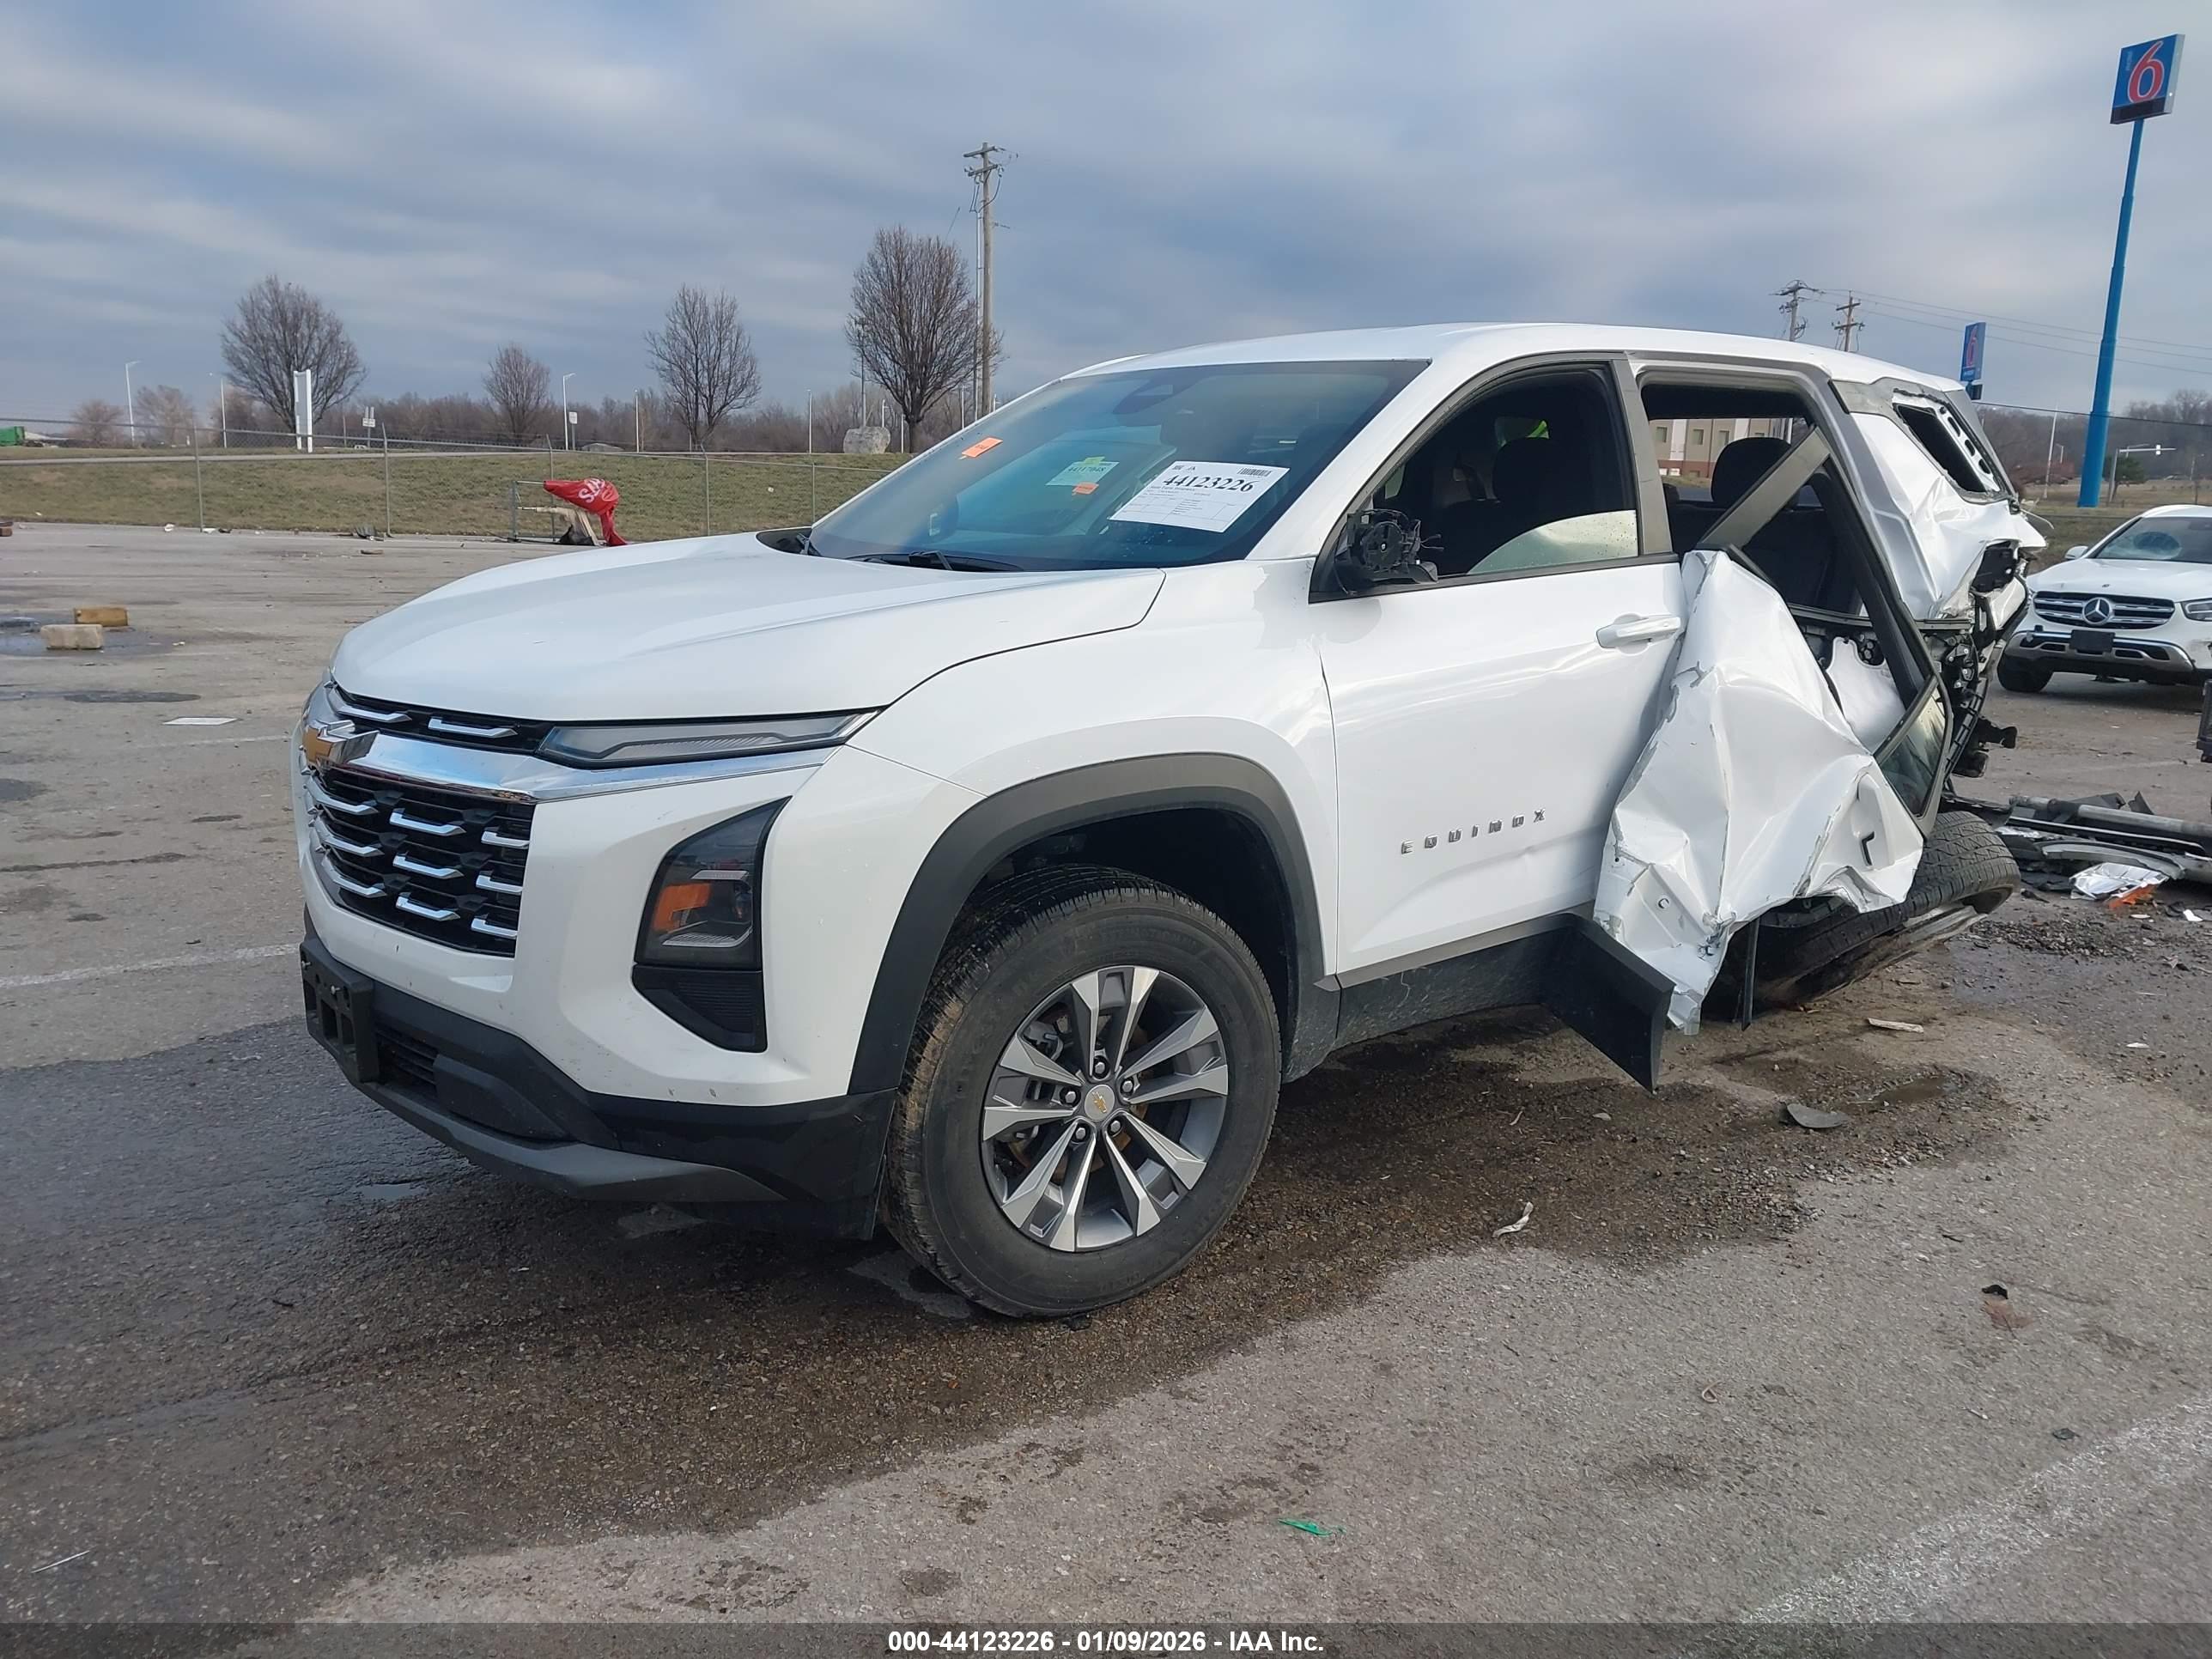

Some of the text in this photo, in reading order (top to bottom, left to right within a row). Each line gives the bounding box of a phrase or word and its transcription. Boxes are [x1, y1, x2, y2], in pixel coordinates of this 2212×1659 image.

[2127, 40, 2165, 103] 6
[1162, 474, 1260, 493] 44123226
[1401, 809, 1546, 854] EQUINOX
